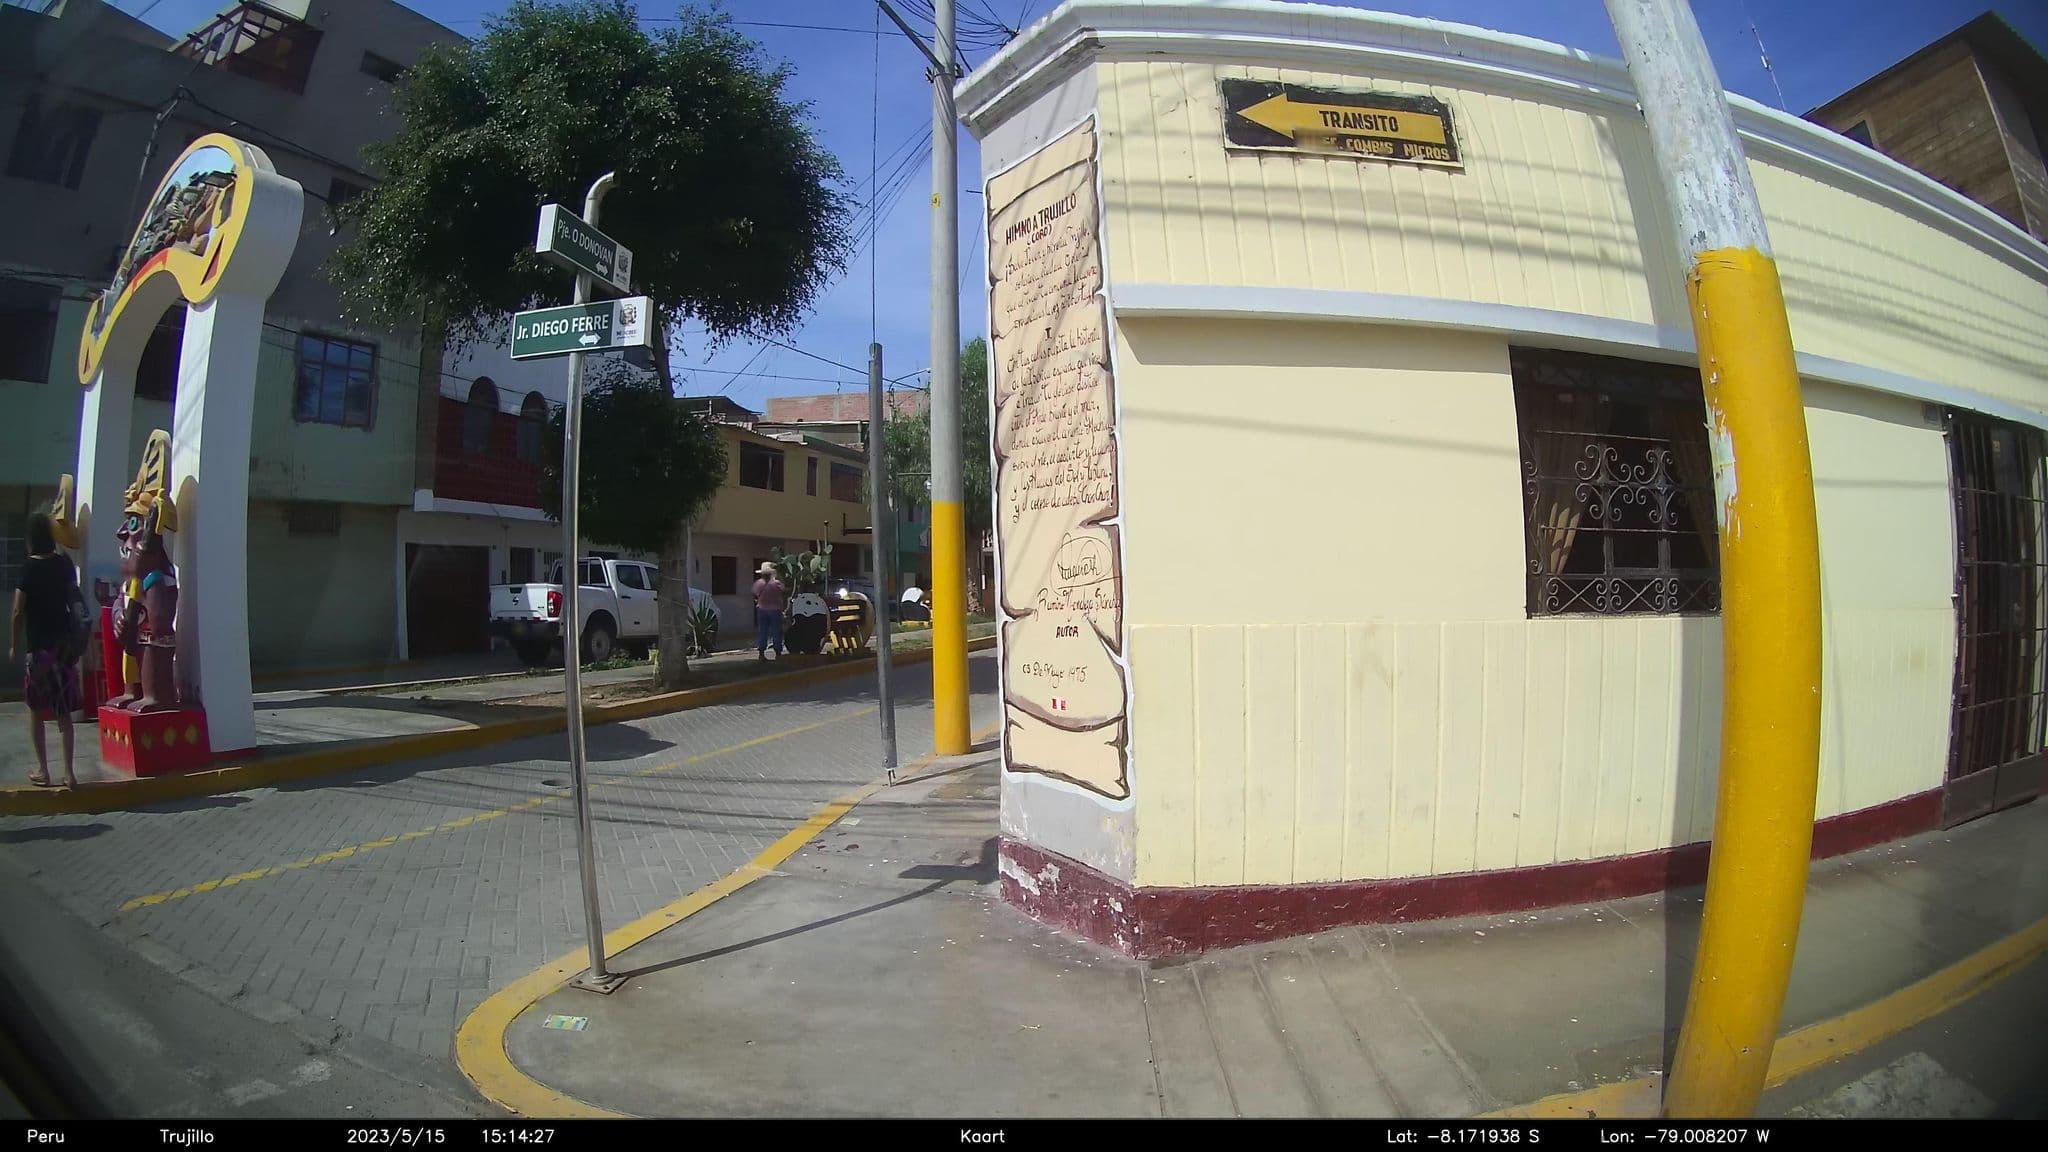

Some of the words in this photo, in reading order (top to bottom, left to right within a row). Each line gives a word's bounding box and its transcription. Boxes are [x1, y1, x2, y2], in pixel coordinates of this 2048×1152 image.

[1319, 110, 1399, 132] TRANSITO
[1345, 138, 1394, 155] COMBIS
[1404, 144, 1450, 160] MICROS
[1006, 217, 1032, 246] HIMNO
[1032, 215, 1039, 233] A
[1038, 192, 1077, 227] TRUJILLO
[557, 219, 571, 239] Pje.
[579, 234, 613, 265] DONOVAN
[516, 325, 529, 341] Jr.
[531, 319, 569, 338] DIEGO
[571, 314, 609, 332] FERRE
[1056, 625, 1079, 638] AUTOR
